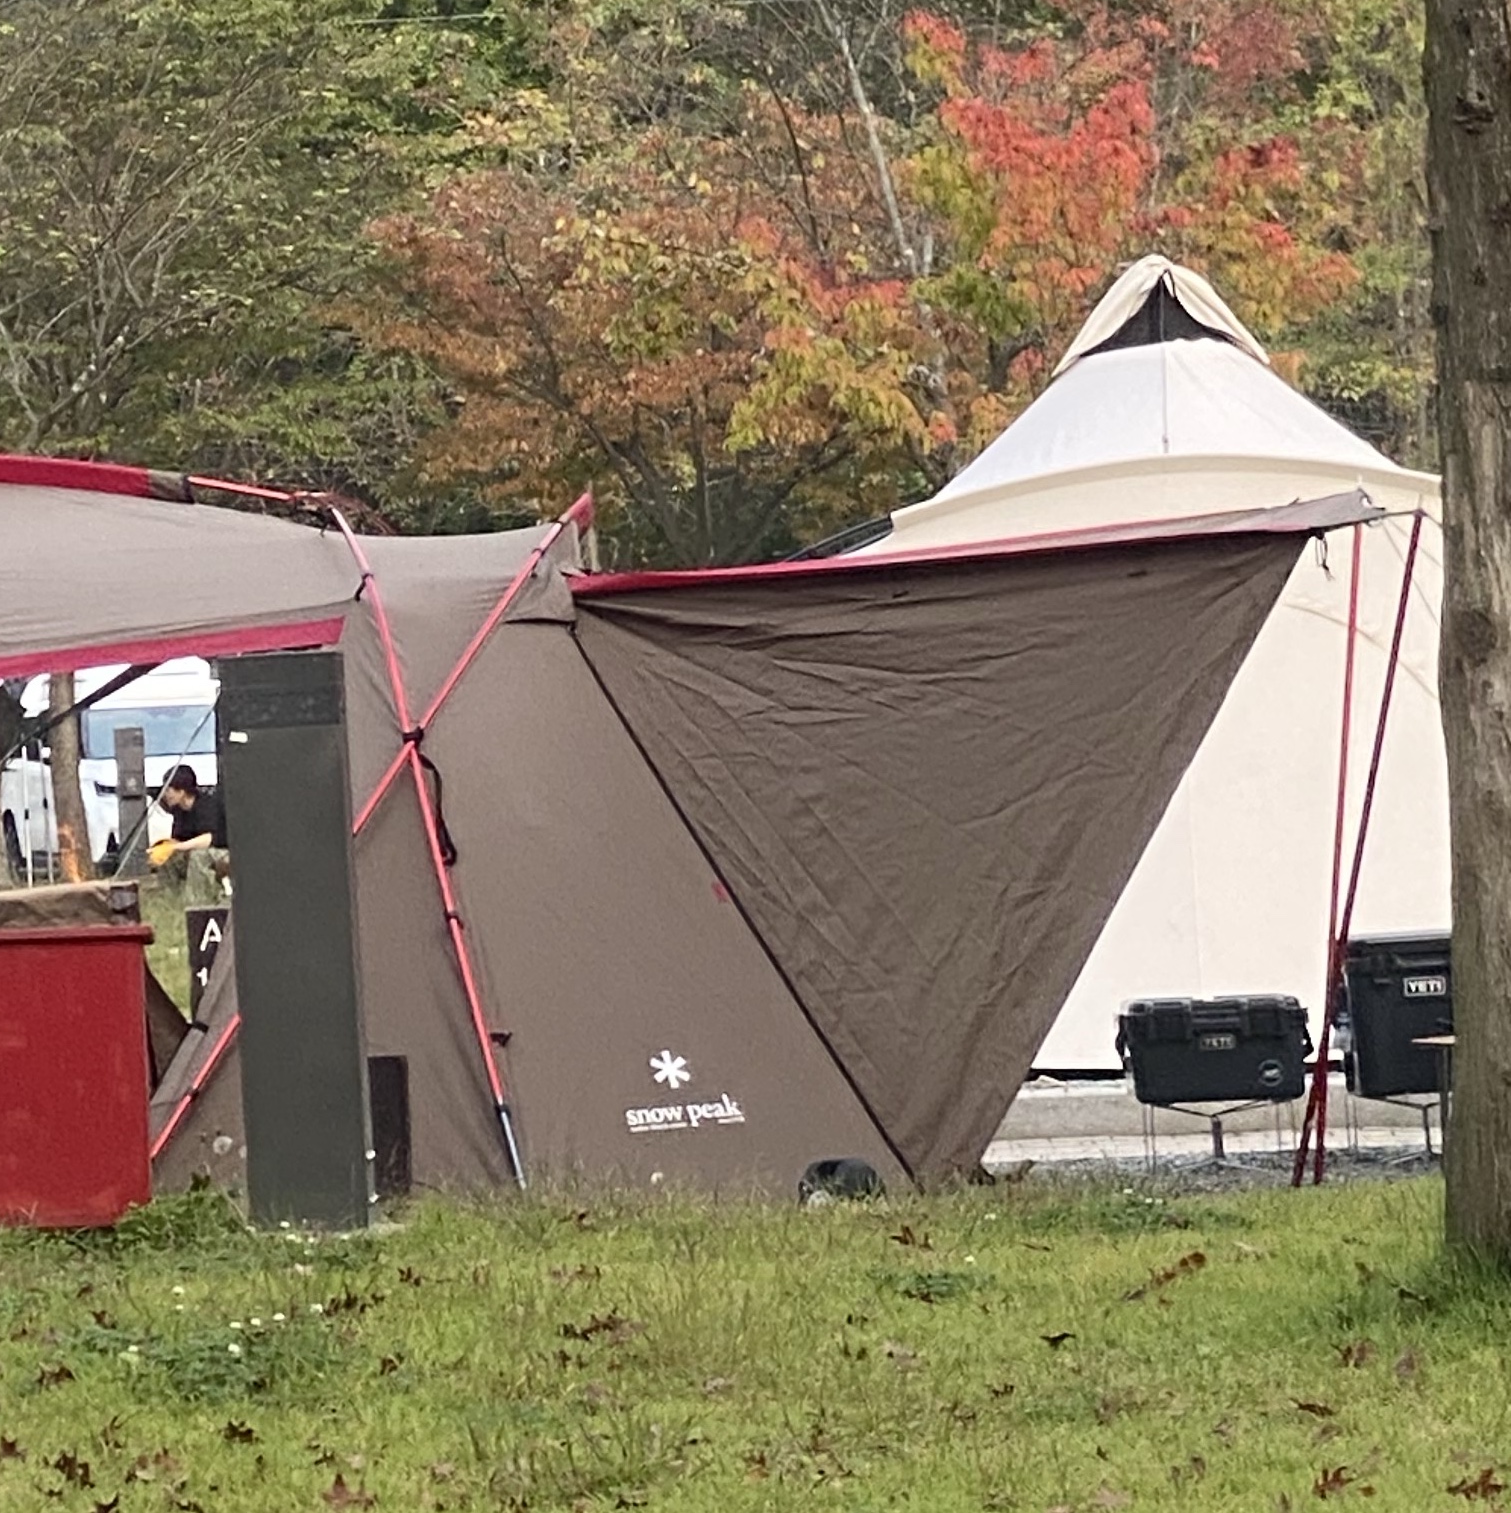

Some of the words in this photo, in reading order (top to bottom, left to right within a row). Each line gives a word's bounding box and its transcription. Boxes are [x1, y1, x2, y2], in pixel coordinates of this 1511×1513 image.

[199, 917, 222, 952] A
[1406, 979, 1443, 994] YETI
[626, 1105, 684, 1126] snow
[686, 1092, 743, 1127] peak
